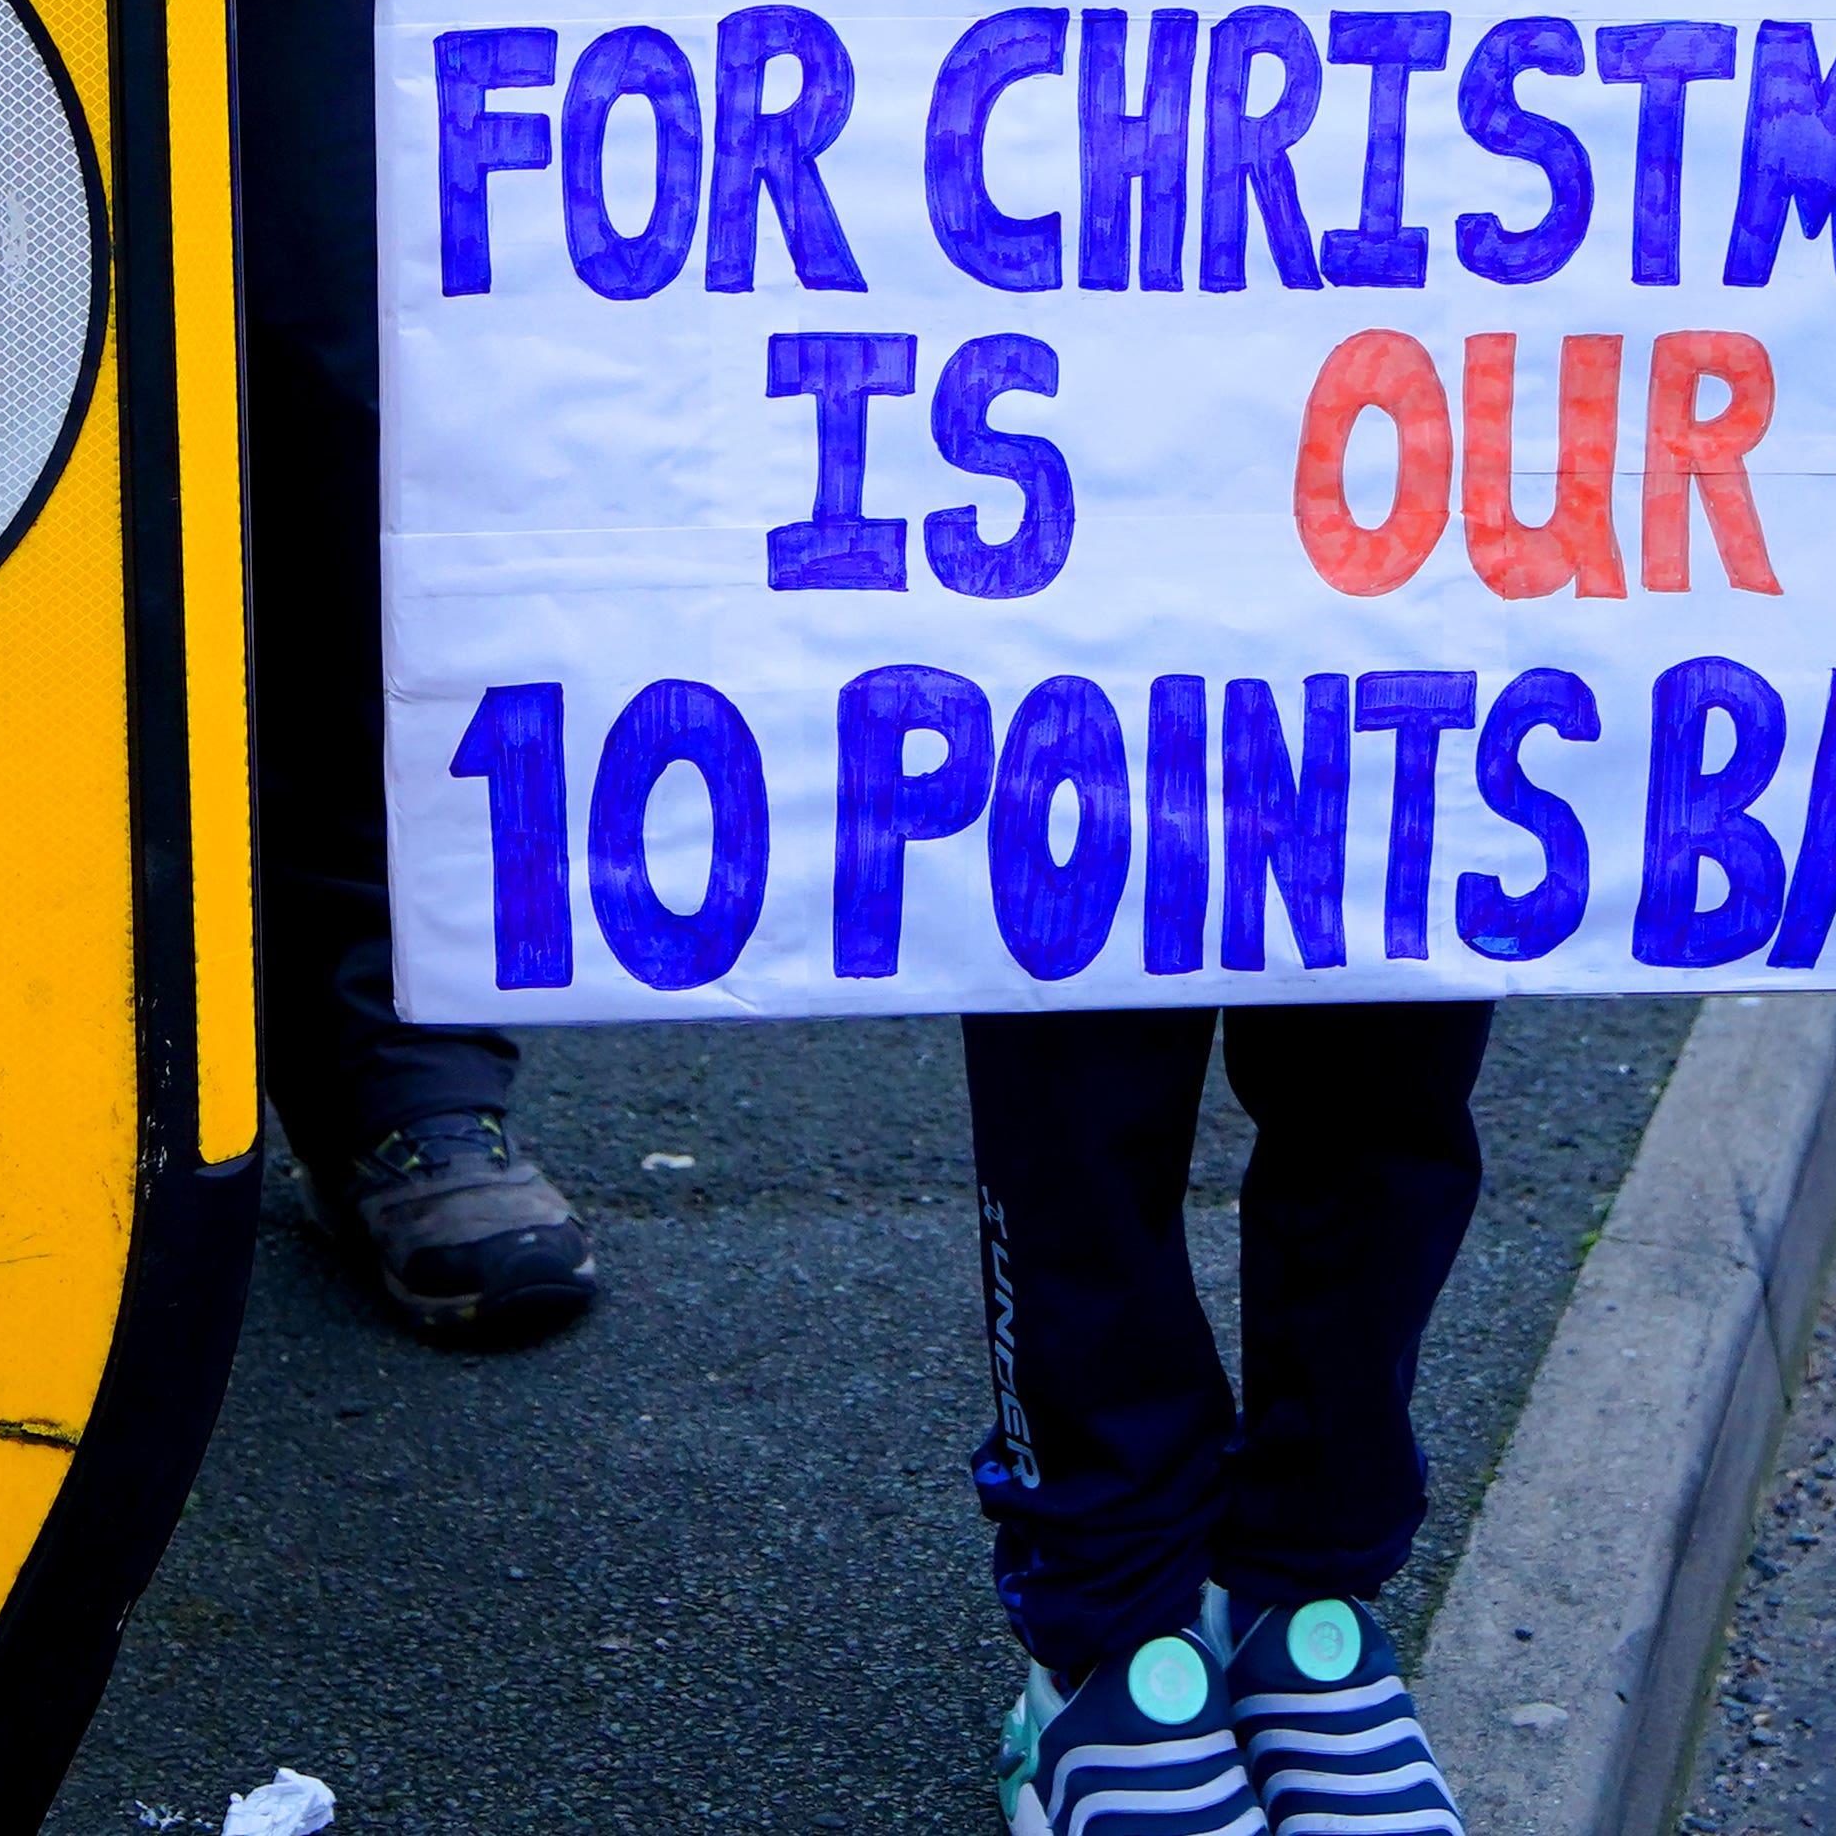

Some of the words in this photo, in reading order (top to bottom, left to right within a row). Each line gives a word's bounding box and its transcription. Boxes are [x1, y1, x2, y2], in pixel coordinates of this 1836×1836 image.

[433, 4, 868, 301] FOR
[766, 331, 1075, 600] IS
[1294, 329, 1782, 600] OUR
[449, 678, 770, 992] 10
[832, 664, 1602, 982] POINTS
[991, 1240, 1041, 1489] UNDER
